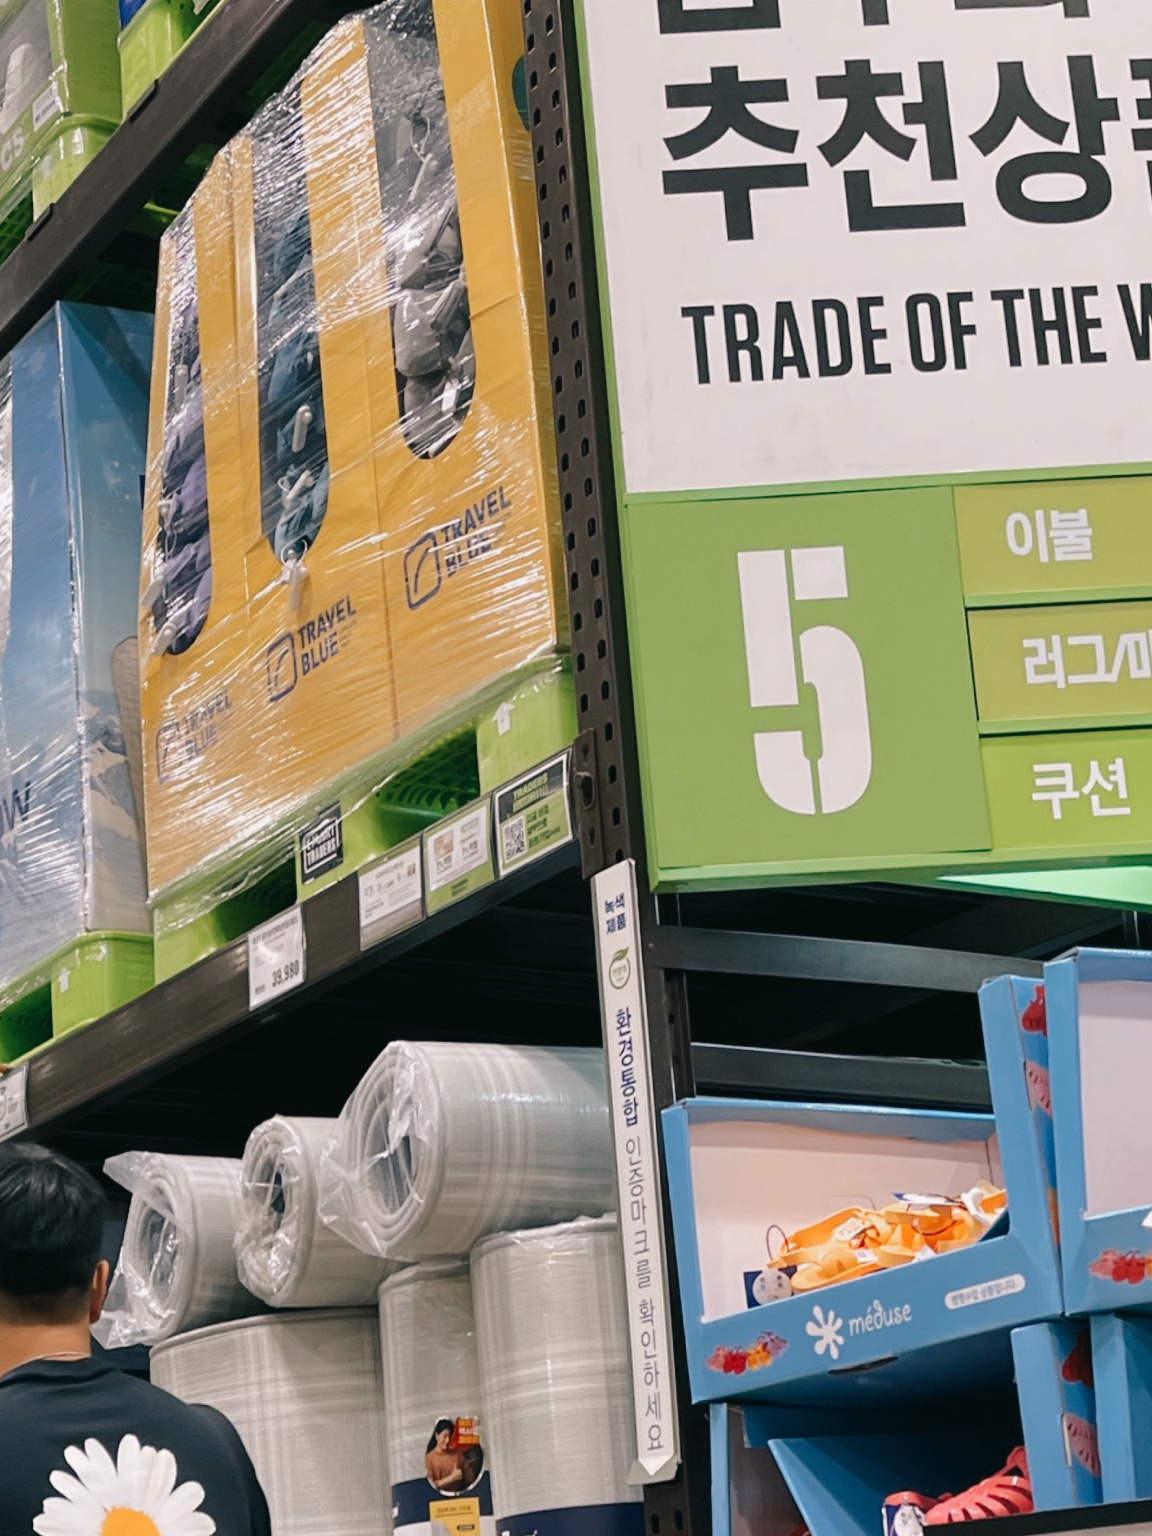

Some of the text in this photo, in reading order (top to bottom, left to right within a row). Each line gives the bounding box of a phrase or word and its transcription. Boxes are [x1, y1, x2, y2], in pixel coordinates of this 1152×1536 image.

[681, 296, 892, 386] TRADE
[905, 291, 978, 373] OF
[990, 285, 1108, 368] THE
[441, 486, 512, 543] TRAVEL
[1005, 508, 1094, 563] 이불
[298, 596, 357, 648] TRAVEL
[301, 631, 339, 676] BLUE
[737, 545, 873, 815] 5
[1032, 757, 1131, 820] 쿠션
[604, 892, 625, 914] 녹색
[606, 912, 627, 935] 제품
[271, 959, 300, 988] 39,980
[848, 1299, 913, 1337] méduse
[638, 1297, 665, 1452] 확인하세요
